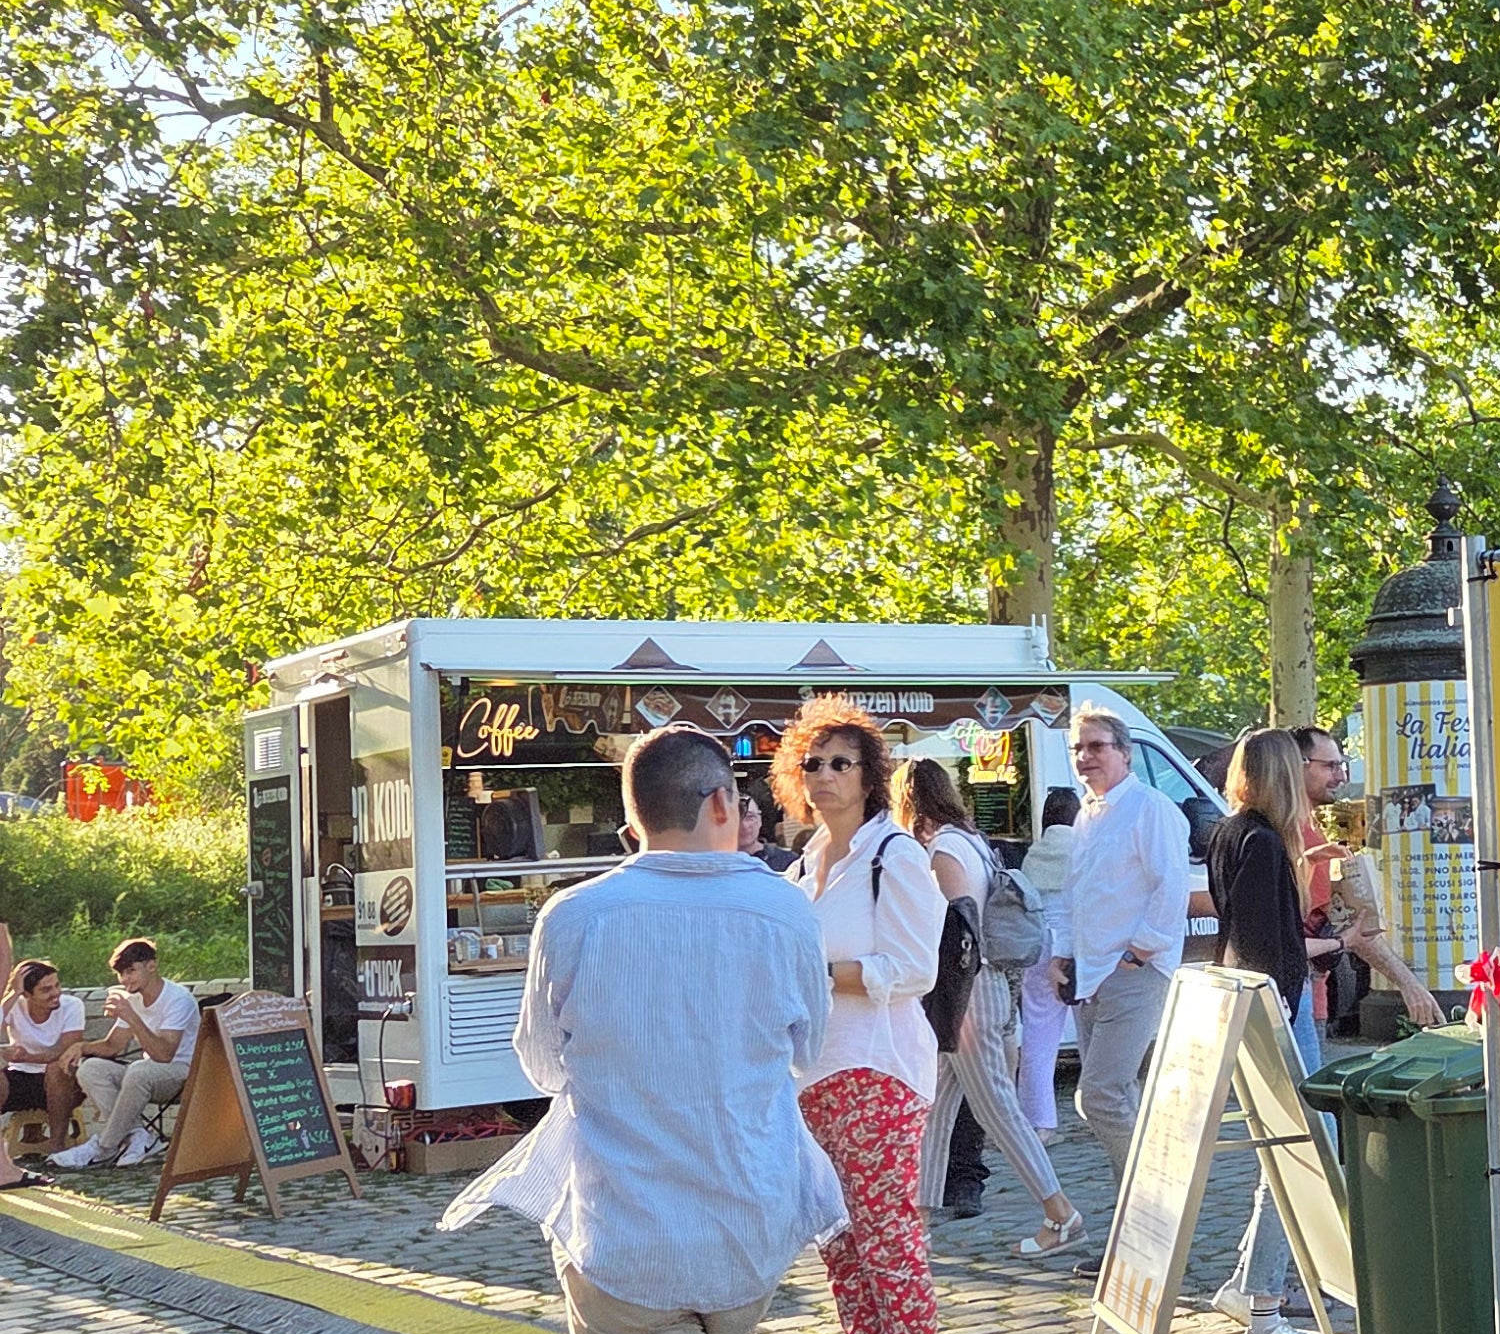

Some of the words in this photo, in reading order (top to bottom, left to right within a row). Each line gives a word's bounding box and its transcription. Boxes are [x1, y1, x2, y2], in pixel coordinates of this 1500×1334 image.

[457, 697, 540, 757] Coffee
[1396, 713, 1426, 738] La
[1405, 853, 1451, 862] CHRISTIAN
[1425, 865, 1449, 874] PINO
[1452, 865, 1475, 873] BAR
[1424, 892, 1448, 901] PINO
